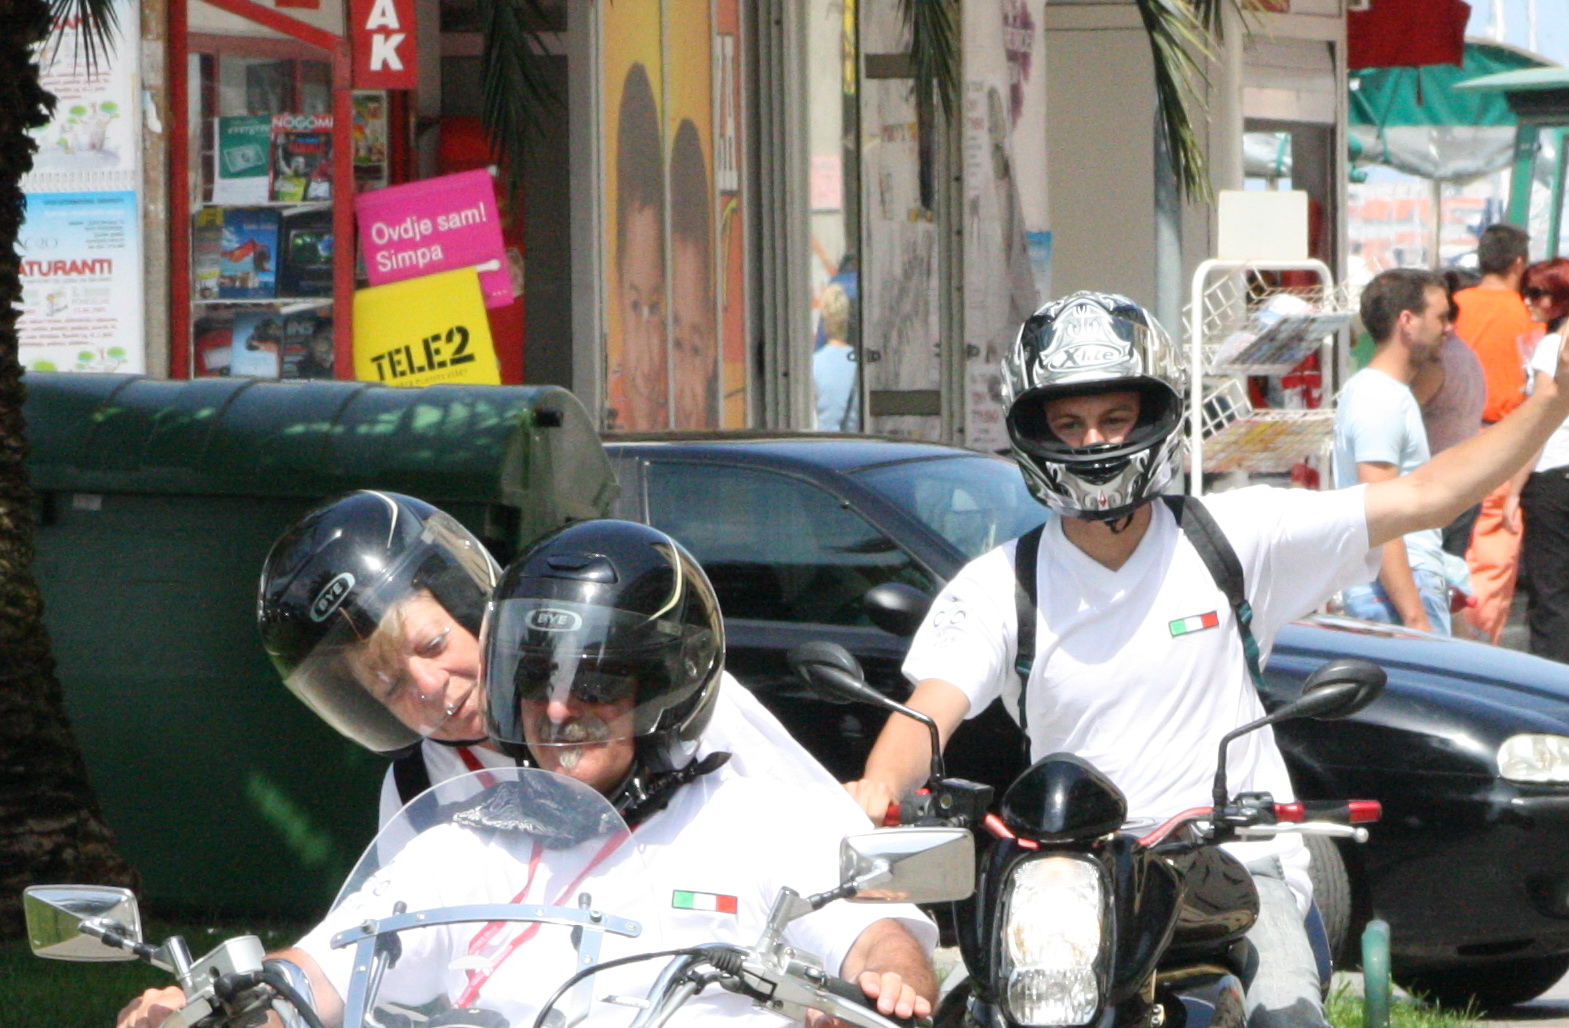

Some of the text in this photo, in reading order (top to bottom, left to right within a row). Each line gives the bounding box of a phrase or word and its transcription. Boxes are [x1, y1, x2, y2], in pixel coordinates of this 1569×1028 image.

[371, 202, 487, 245] Ovdje sam!
[17, 259, 113, 277] ATURANTI
[376, 245, 444, 273] Simpa
[370, 325, 476, 381] TELE2
